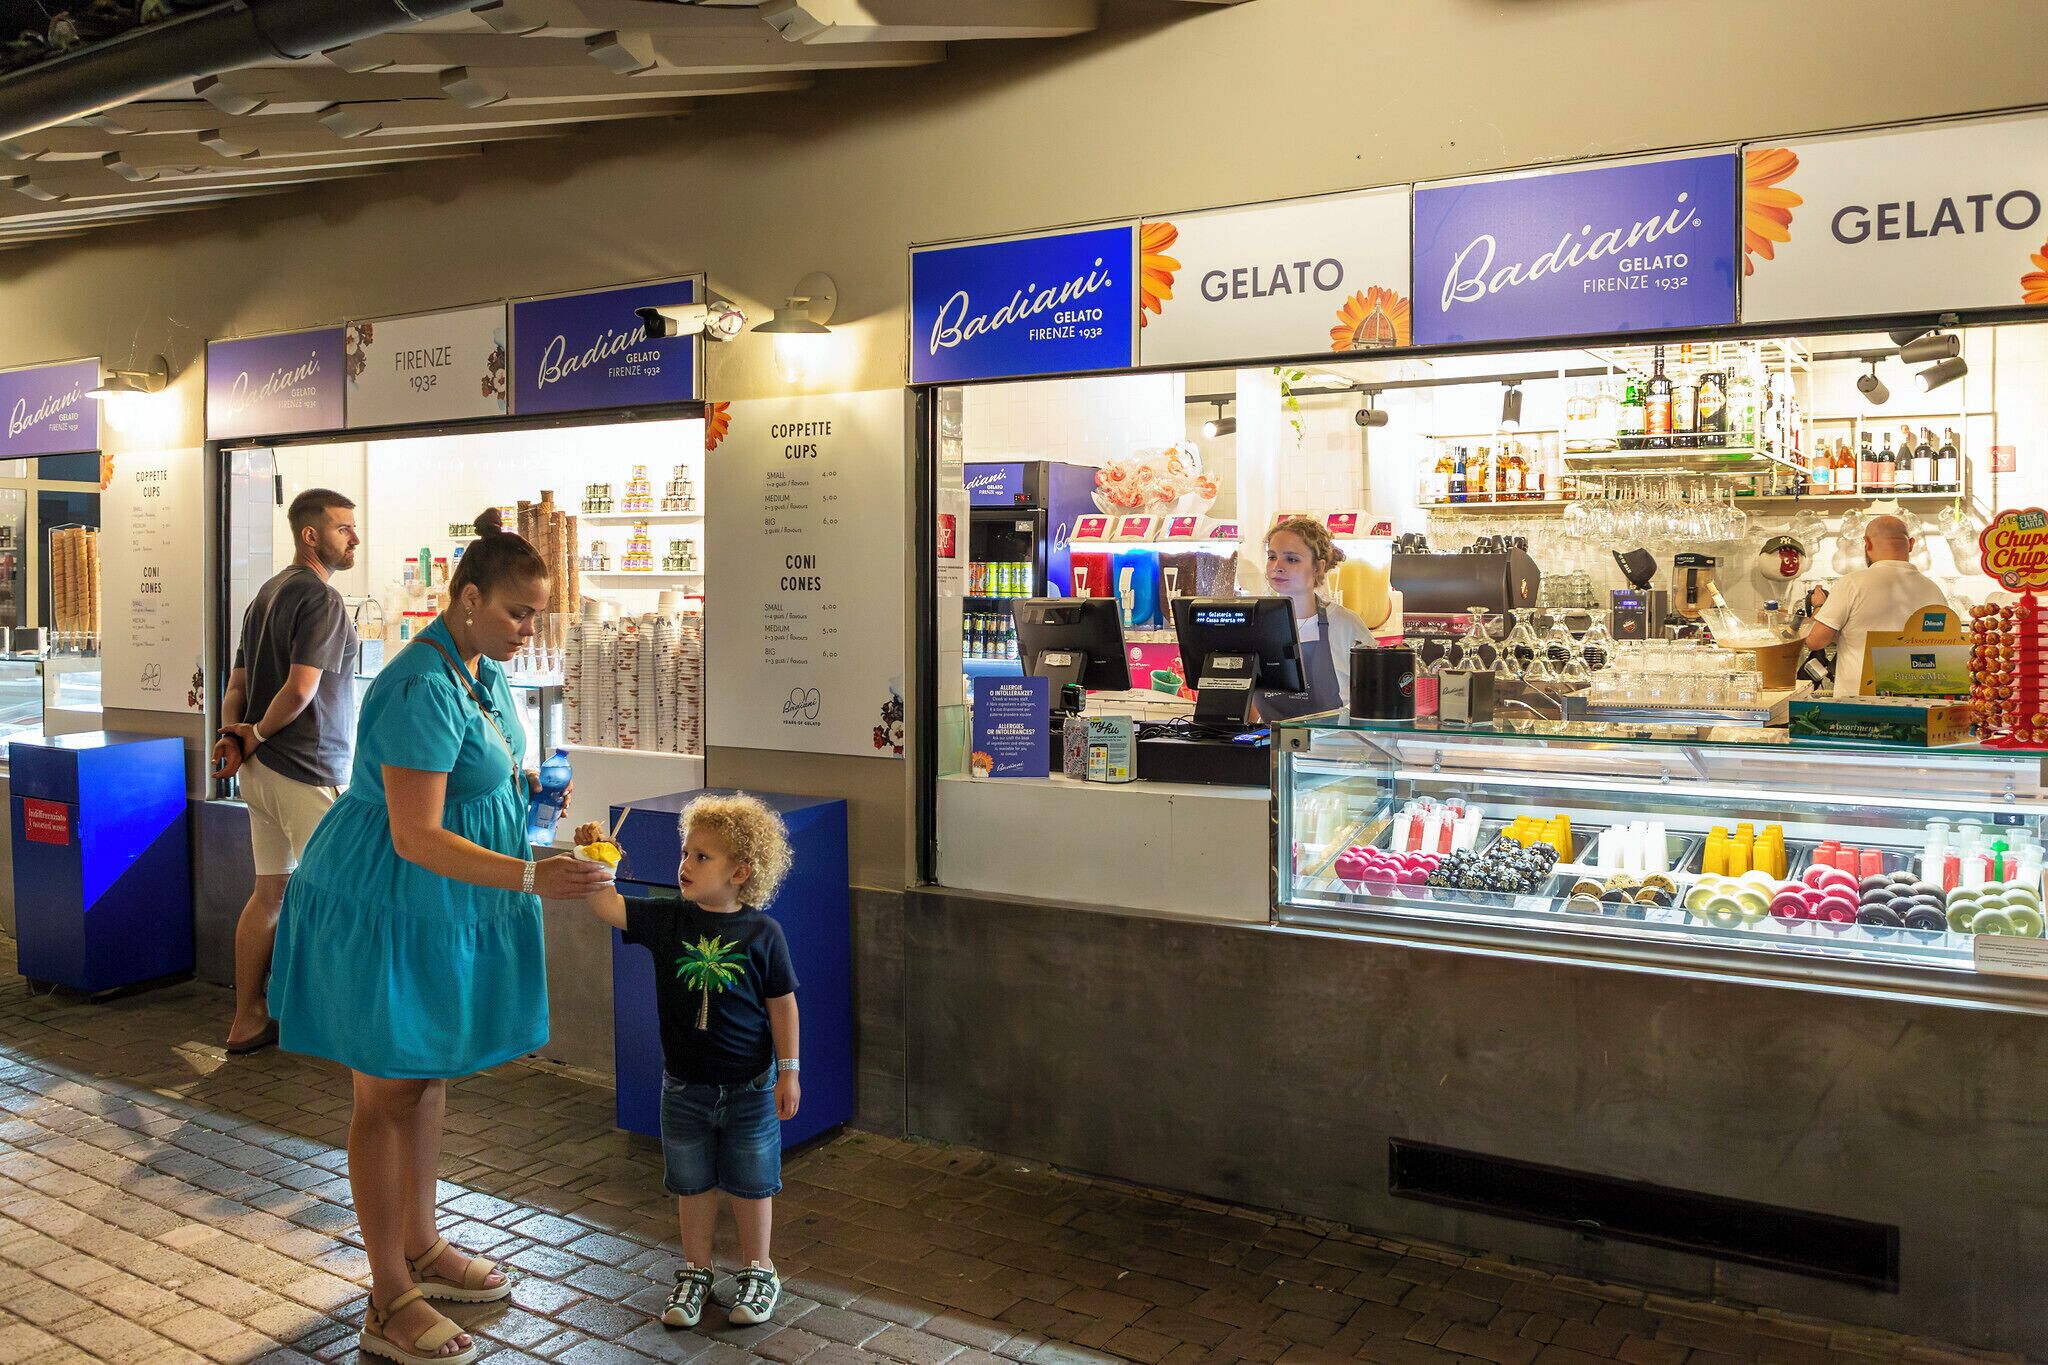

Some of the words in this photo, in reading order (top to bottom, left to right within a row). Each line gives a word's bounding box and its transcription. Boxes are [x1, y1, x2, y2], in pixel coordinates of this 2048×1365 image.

[1831, 190, 2042, 244] GELATO
[1618, 253, 1689, 273] GELATO
[1200, 257, 1344, 302] GELATO
[1583, 274, 1649, 294] FIRENZE
[1653, 276, 1689, 291] 1932
[1053, 308, 1103, 325] GELATO
[1029, 326, 1076, 341] FIRENZE
[1078, 327, 1103, 340] 1932
[394, 346, 452, 372] FIRENZE
[537, 322, 648, 390] Badian
[625, 350, 661, 364] GELATO
[608, 364, 641, 379] FIRENZE
[643, 366, 661, 378] 1932
[409, 374, 437, 393] 1932
[291, 386, 316, 398] GELATO
[278, 400, 302, 409] FIRENZE
[1699, 395, 1722, 404] VERNA
[58, 412, 79, 422] GELATO
[48, 422, 68, 432] FIRENZE
[771, 421, 832, 439] COPPETTE
[785, 444, 817, 460] CUPS
[136, 470, 168, 482] COPPETTE
[766, 471, 786, 480] SMALL
[963, 468, 1005, 491] diani
[143, 486, 161, 498] CUPS
[764, 494, 790, 503] MEDIUM
[764, 517, 776, 526] BIG
[785, 554, 816, 570] CONI
[143, 566, 160, 578] CONI
[140, 582, 162, 594] CONES
[780, 576, 822, 591] CONES
[764, 603, 783, 612] SMALL
[1924, 619, 1944, 627] Dilmah
[1907, 637, 1957, 647] Assortment
[764, 647, 776, 656] BIG
[1912, 660, 1936, 668] Dilmah
[986, 728, 995, 736] OR
